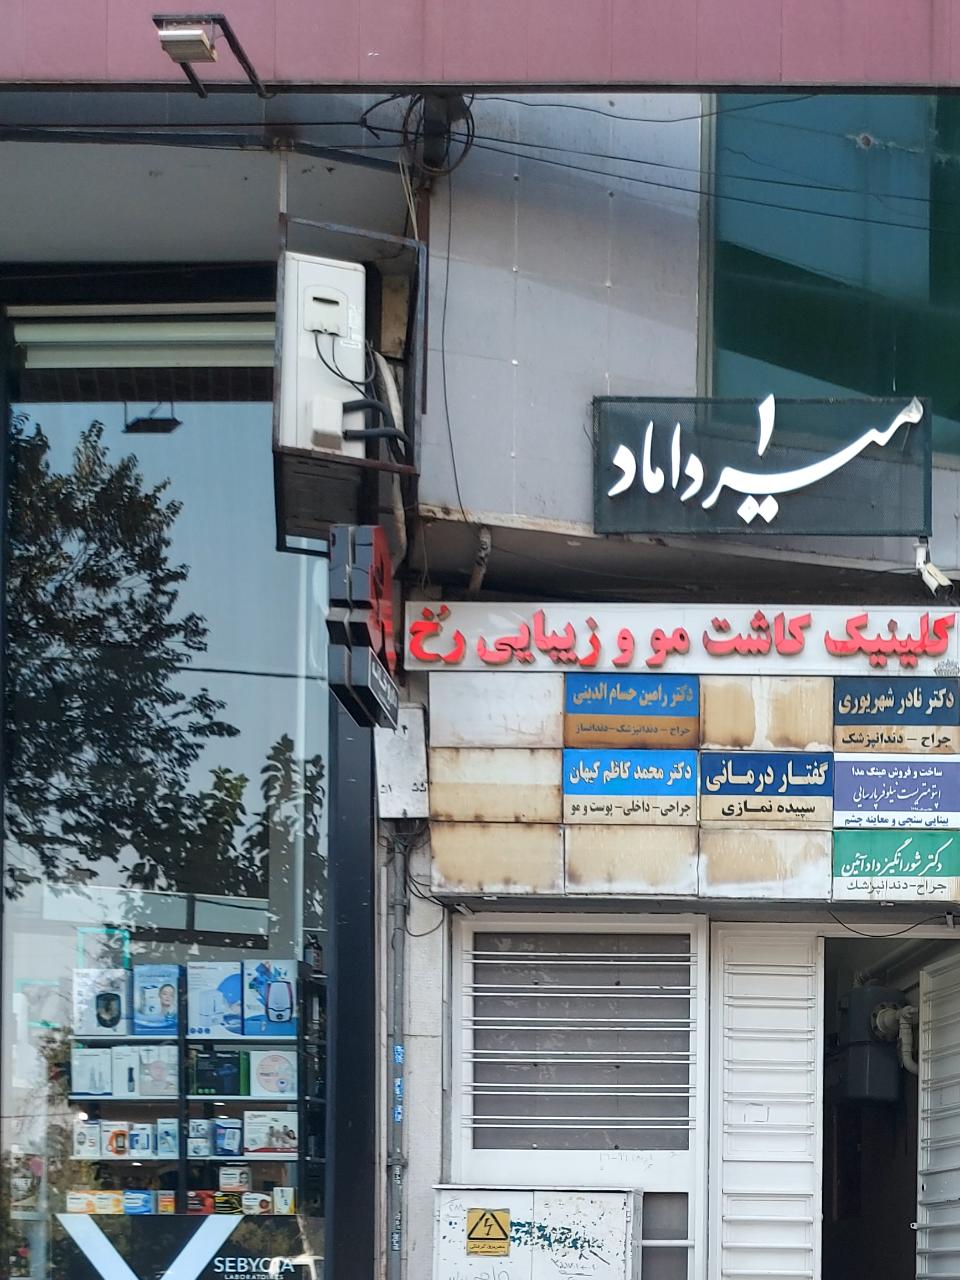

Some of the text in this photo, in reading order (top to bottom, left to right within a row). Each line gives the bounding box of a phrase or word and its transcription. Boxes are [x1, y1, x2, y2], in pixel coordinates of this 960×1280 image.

[477, 608, 602, 667] زیبایی
[703, 610, 812, 657] کاشت
[825, 611, 956, 668] کلینیک
[611, 628, 635, 668] و
[645, 626, 691, 668] مو
[572, 682, 694, 707] دکتر رامین حسام الدینی
[838, 686, 955, 715] دکتر نادر شهریوری
[842, 732, 904, 748] دندانپزشک
[921, 733, 951, 748] جراح
[569, 759, 692, 785] دکتر محمد کاظم کیهان
[705, 760, 829, 793] گفتار درمانی
[851, 765, 943, 779] ساخت و فروش عینک مدا
[570, 805, 582, 816] مو
[583, 806, 589, 815] و
[590, 800, 613, 816] پوست
[721, 799, 816, 820] سپیده نمازی
[865, 814, 889, 826] معاینه
[898, 815, 923, 827] سنجی
[925, 815, 949, 827] بینایی
[918, 837, 953, 876] دکتر
[213, 1257, 295, 1273] SEBYCTA
